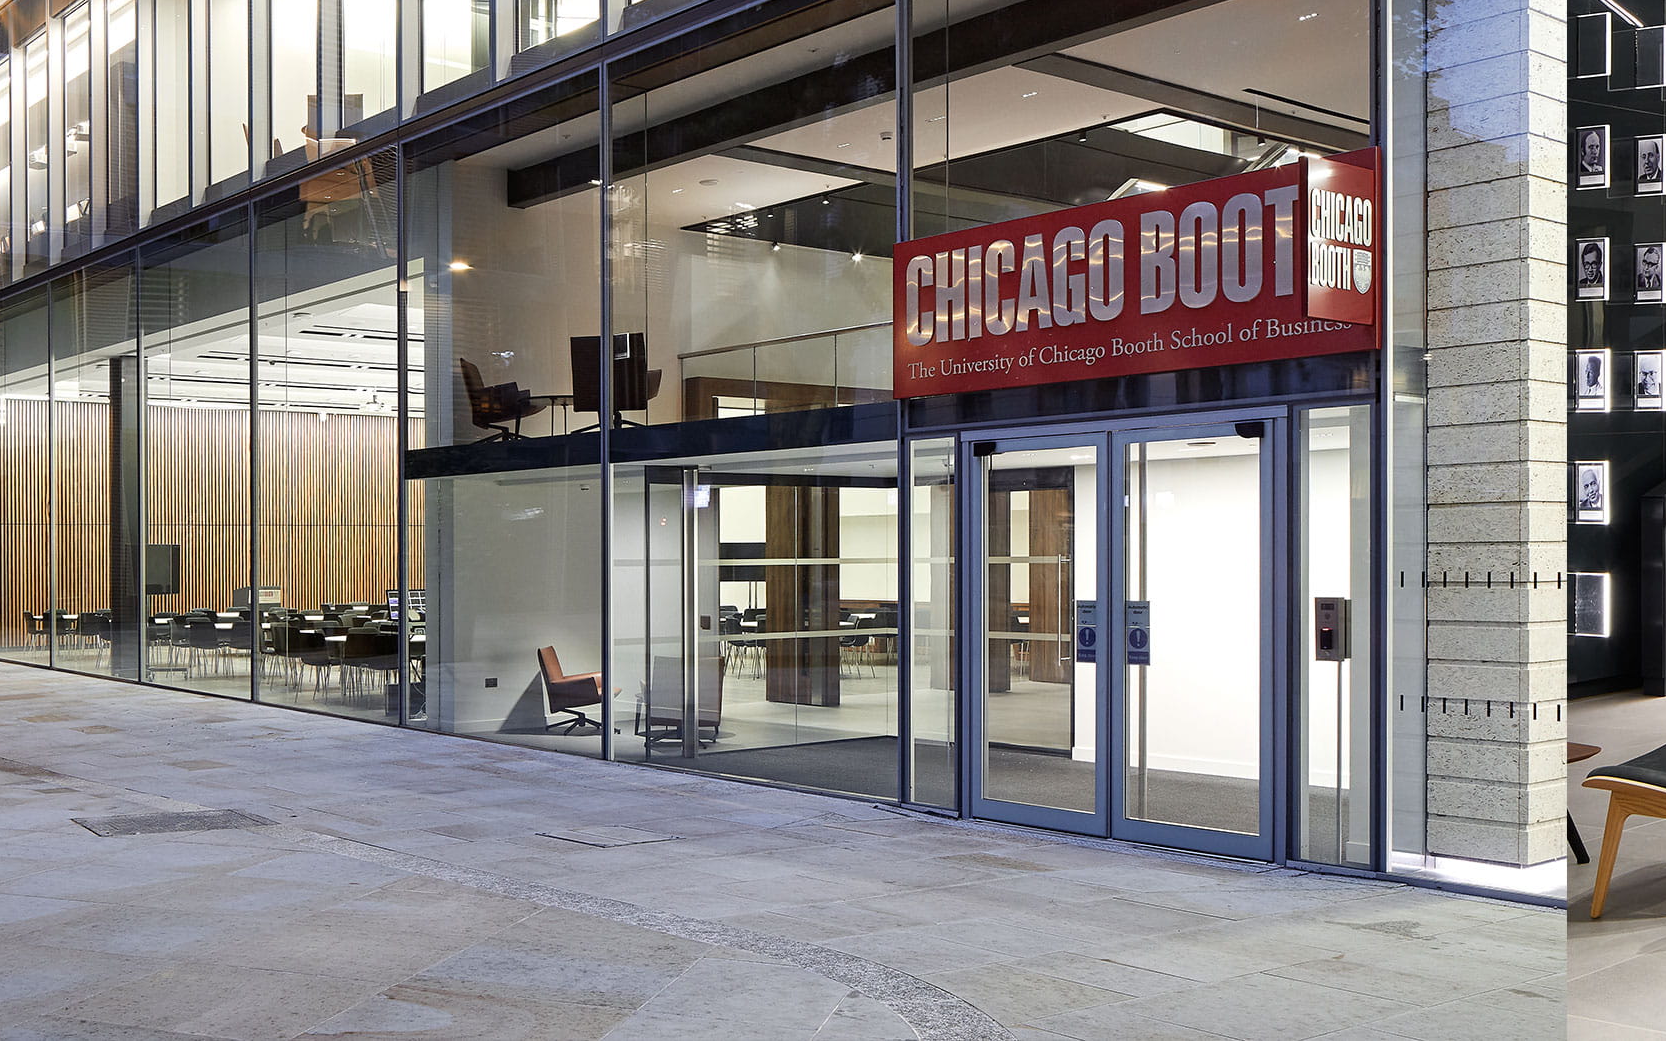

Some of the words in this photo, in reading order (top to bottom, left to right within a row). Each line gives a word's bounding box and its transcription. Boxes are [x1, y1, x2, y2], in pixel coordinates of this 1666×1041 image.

[1311, 188, 1372, 247] CHICAGO
[906, 219, 1124, 346] CHICAGO
[1141, 185, 1299, 315] BOOT
[1309, 241, 1351, 290] BOOTH
[908, 362, 936, 379] The
[940, 354, 1014, 374] University
[1019, 348, 1037, 367] of
[1039, 345, 1105, 365] Chicago
[1111, 332, 1165, 356] Booth
[1170, 323, 1233, 349] School
[1239, 319, 1262, 341] of
